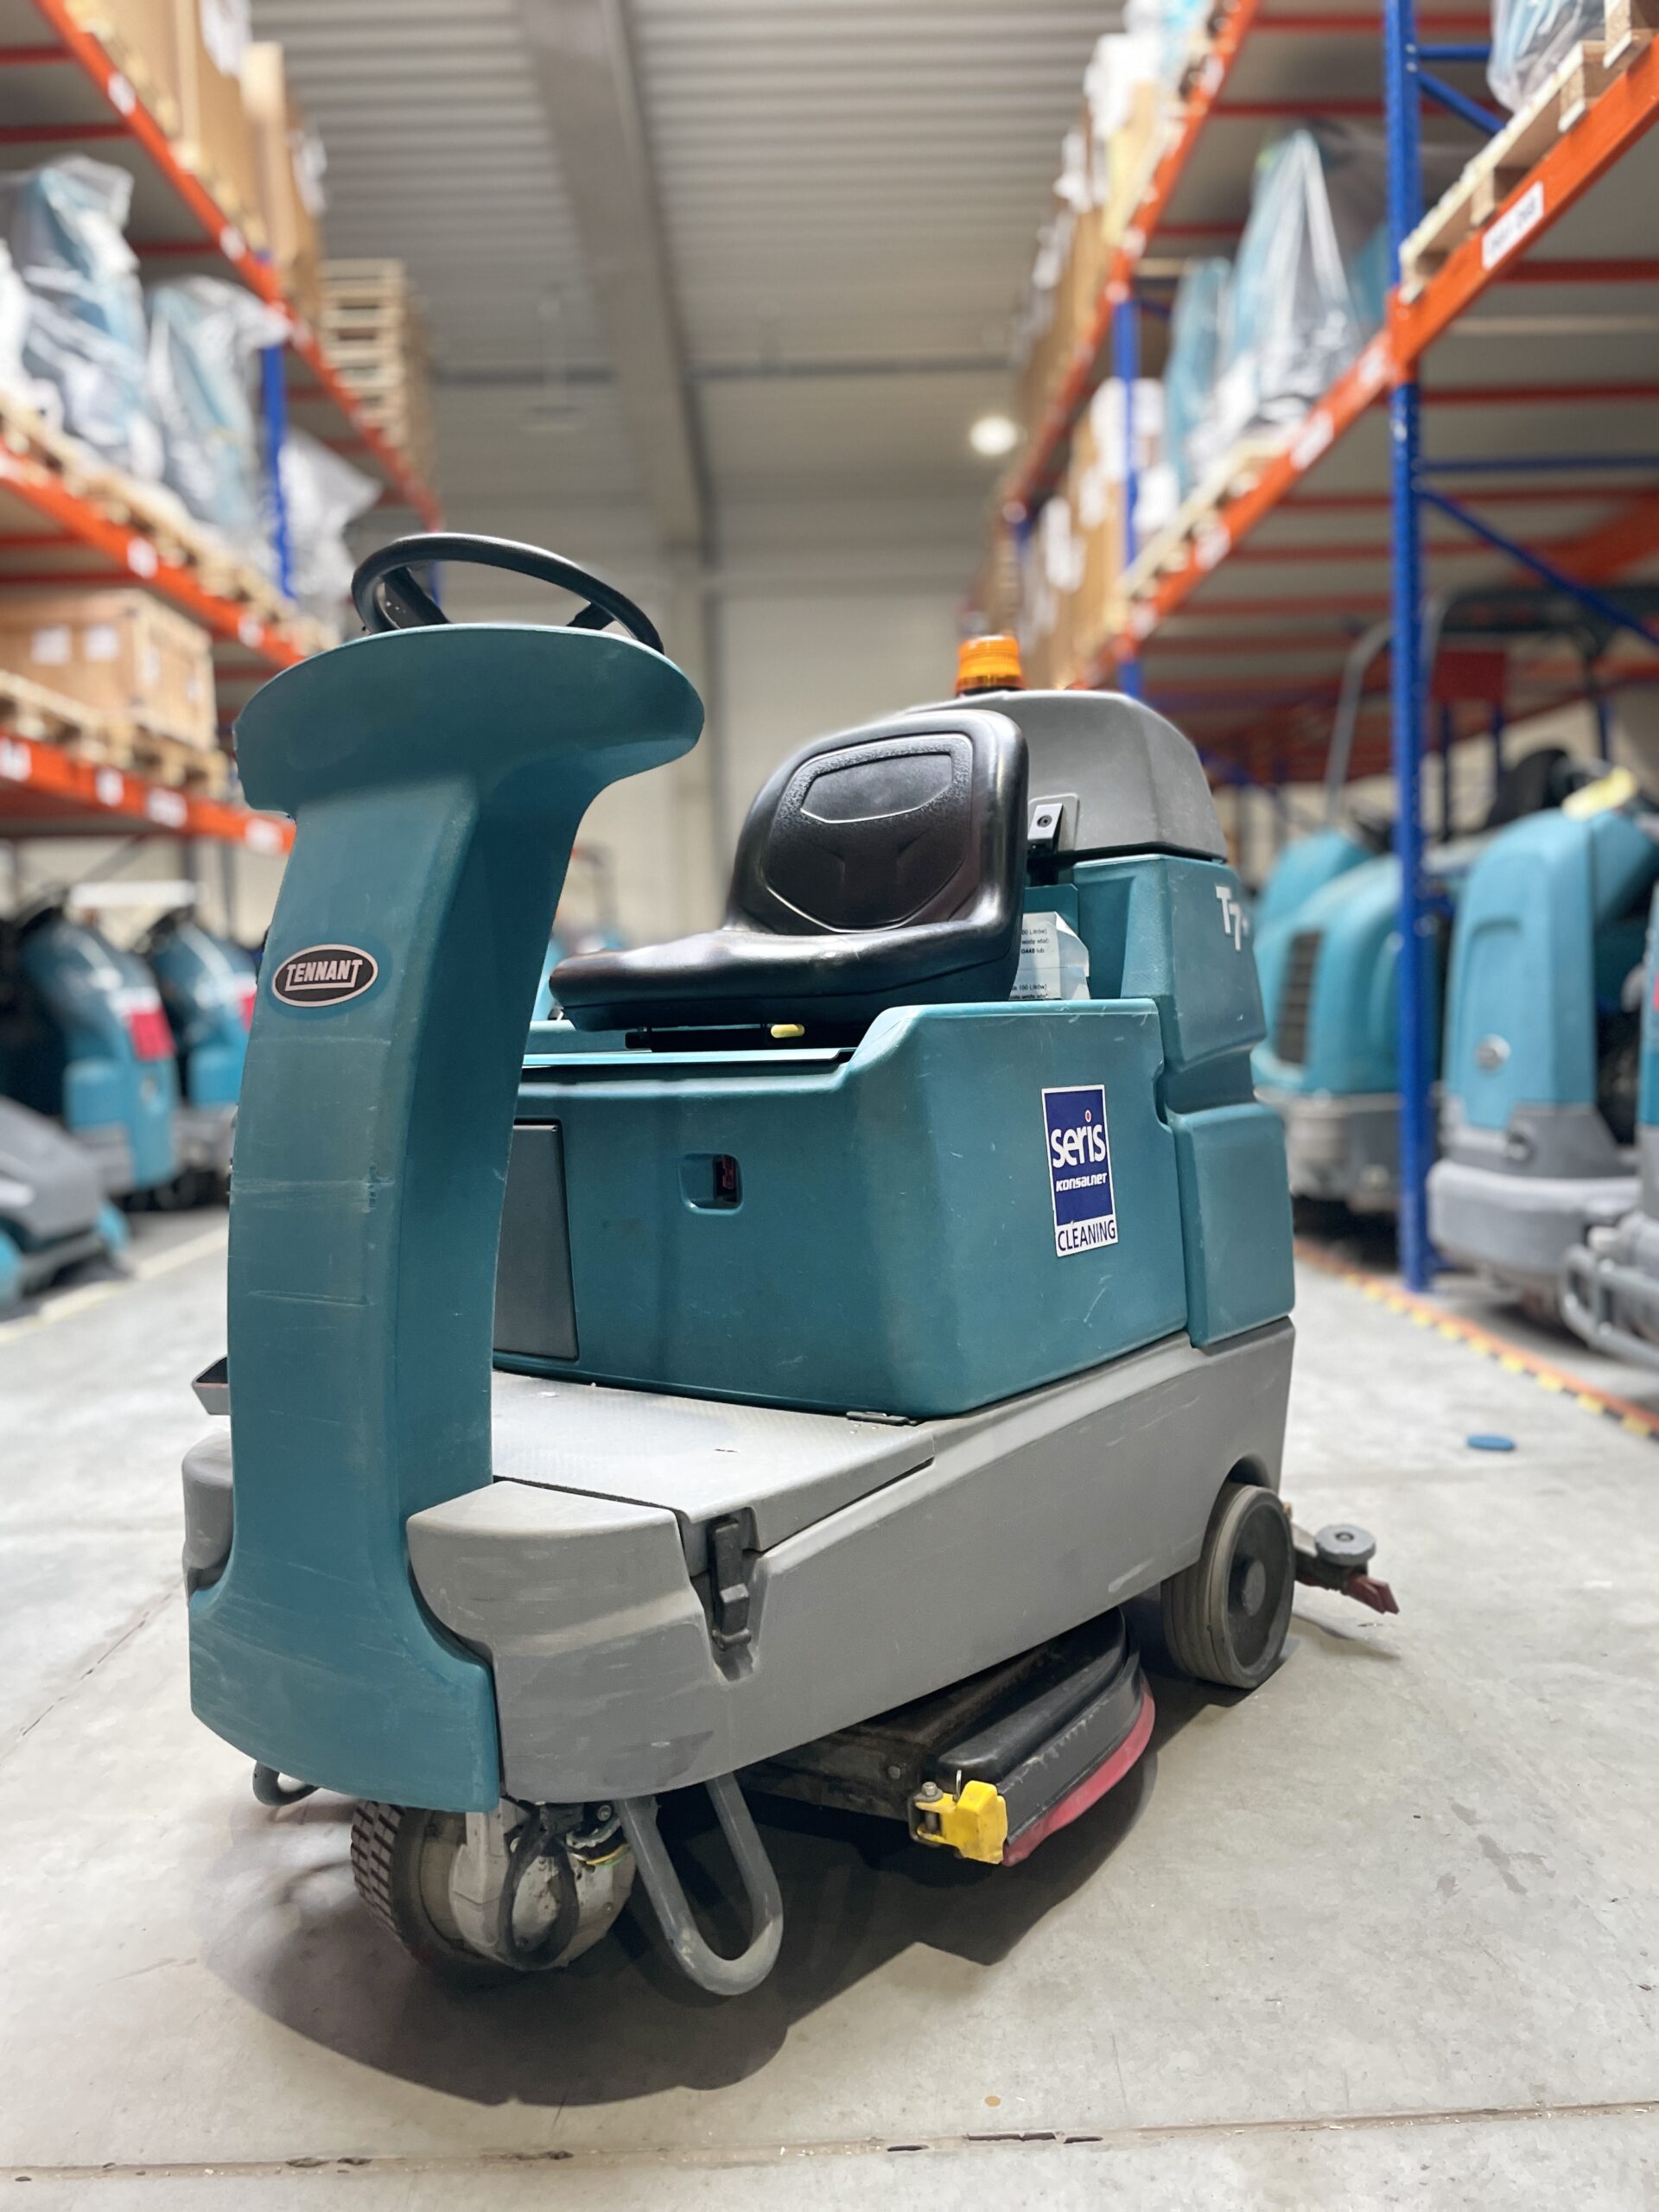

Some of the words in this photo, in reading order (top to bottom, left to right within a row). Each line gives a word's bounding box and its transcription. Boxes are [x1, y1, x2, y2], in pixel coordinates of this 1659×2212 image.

[284, 959, 363, 991] TENNANT
[1051, 1109, 1107, 1168] seris
[1058, 1219, 1116, 1251] CLEANING
